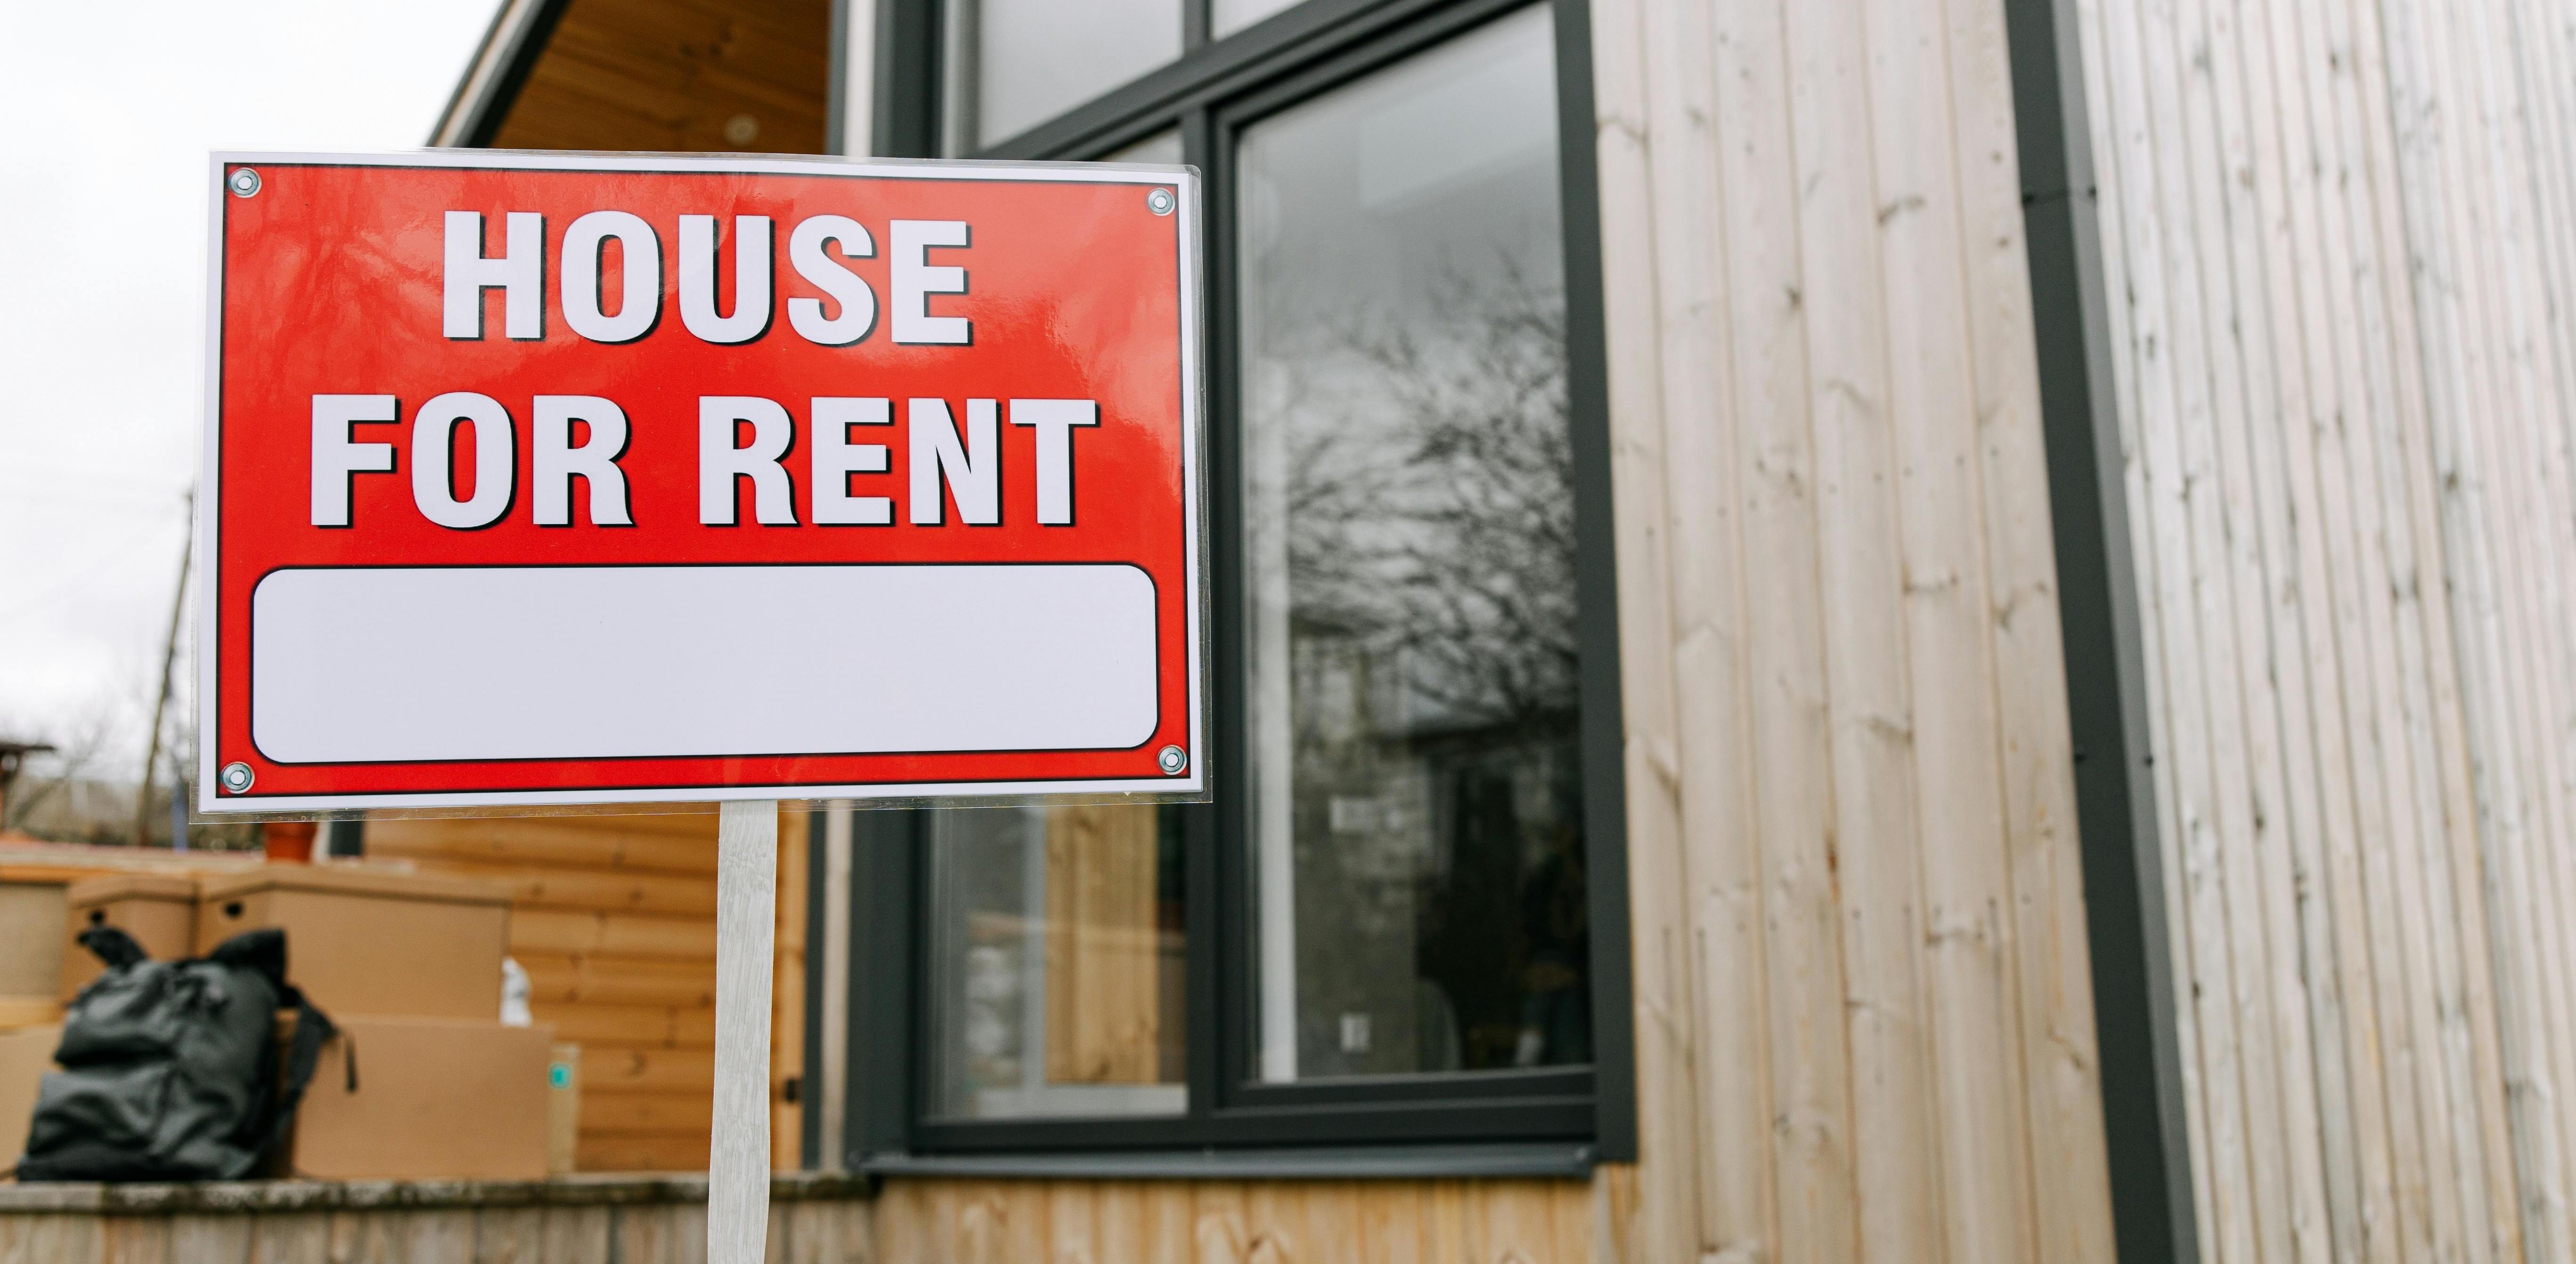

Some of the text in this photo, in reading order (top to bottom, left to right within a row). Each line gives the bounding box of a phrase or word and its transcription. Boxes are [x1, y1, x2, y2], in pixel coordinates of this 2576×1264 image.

[444, 211, 968, 344] HOUSE
[312, 392, 1095, 527] FOR RENT
